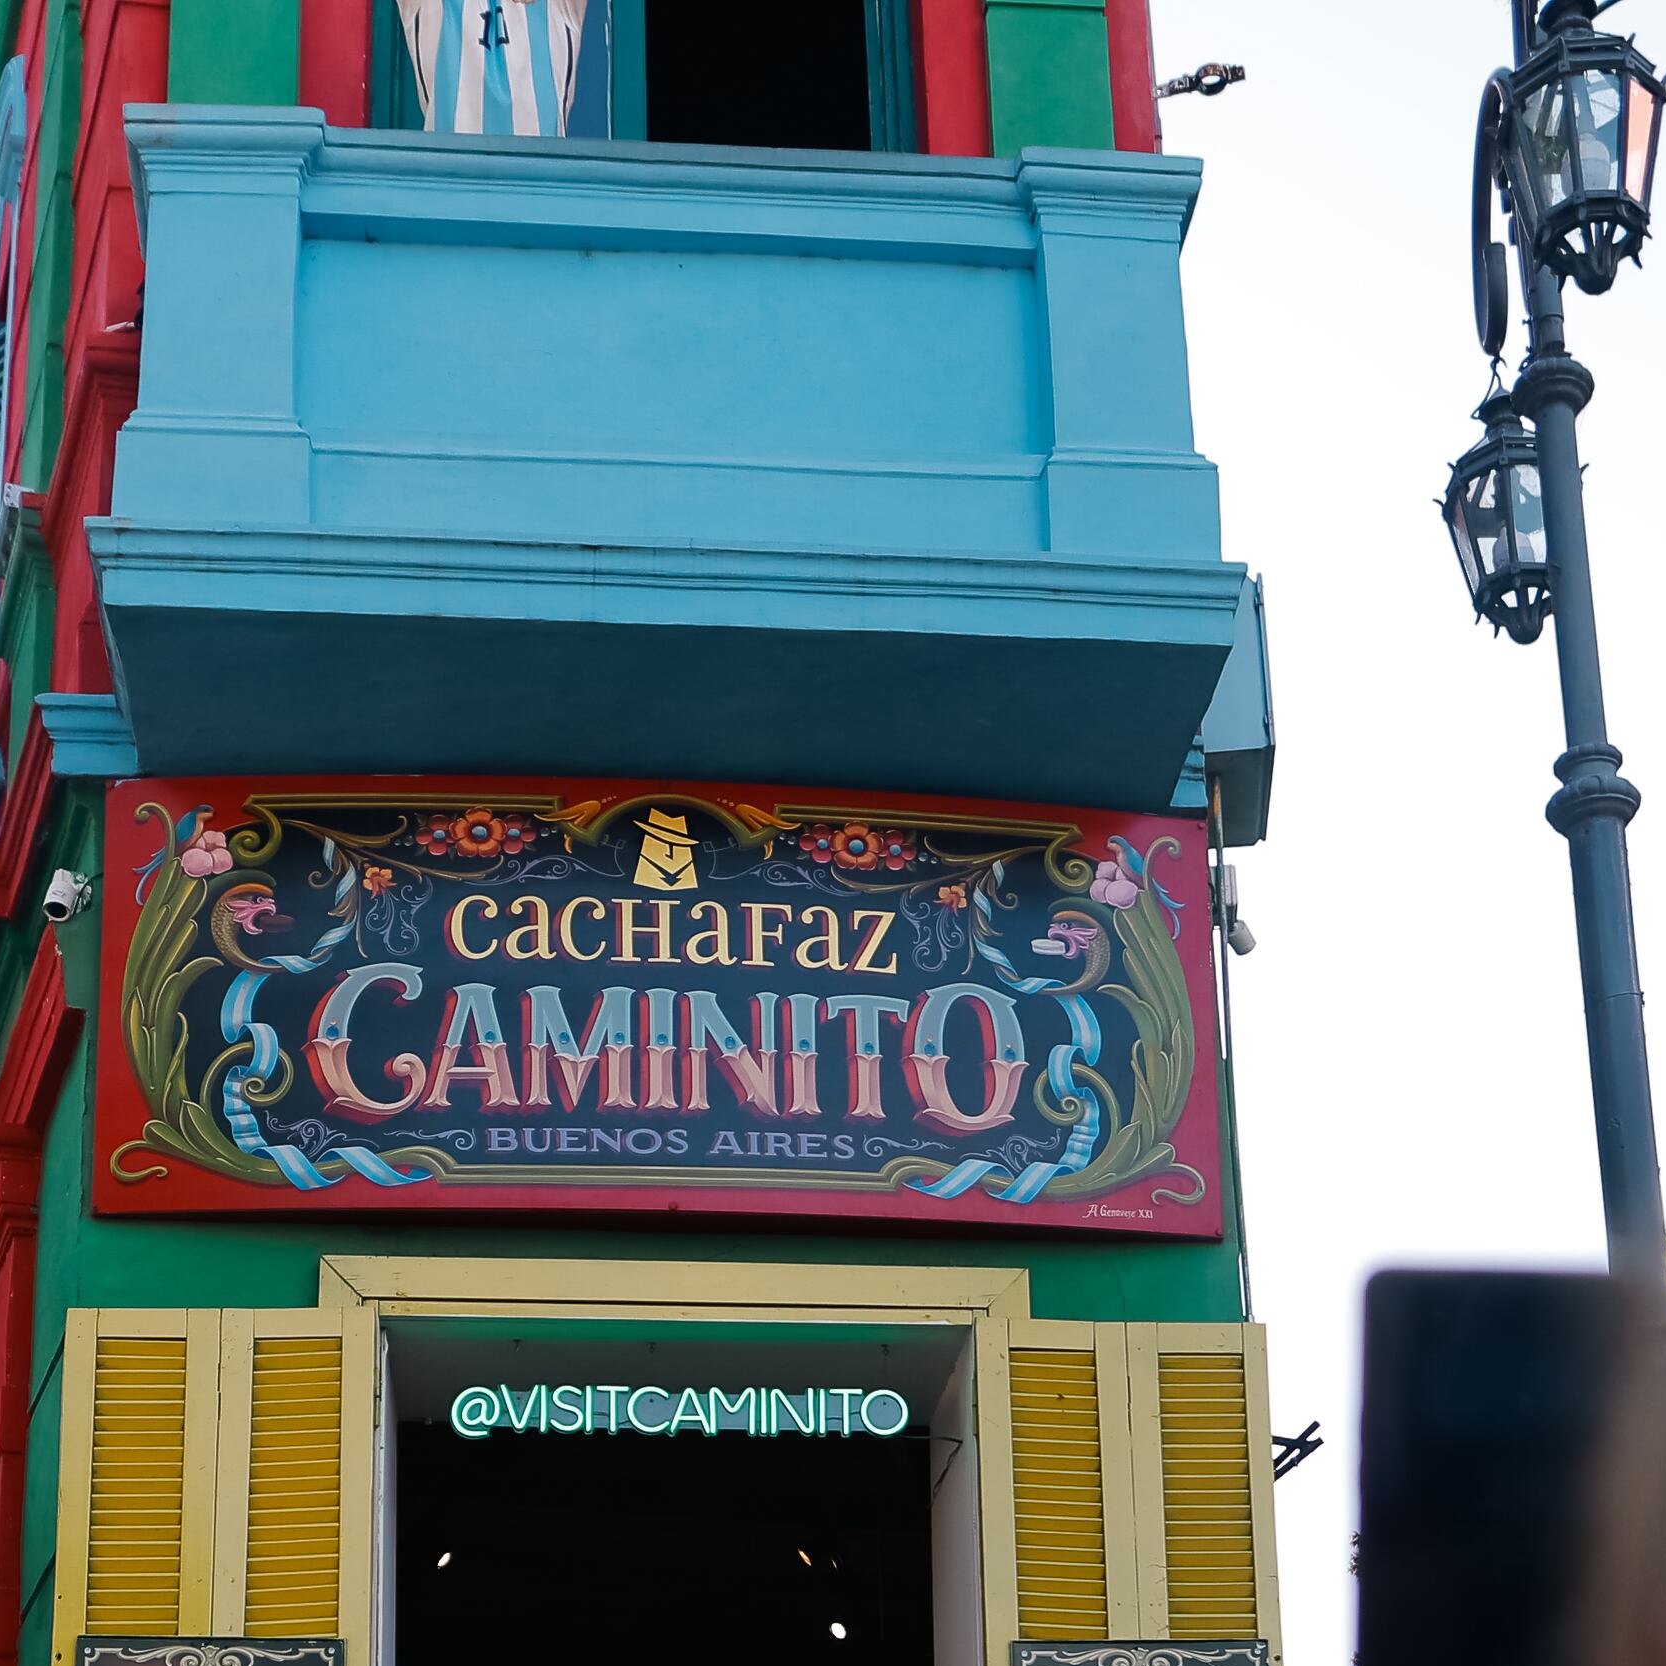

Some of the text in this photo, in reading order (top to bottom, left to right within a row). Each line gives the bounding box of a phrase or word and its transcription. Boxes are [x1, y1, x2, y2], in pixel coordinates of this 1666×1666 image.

[304, 962, 1030, 1132] CAMINITO
[486, 1127, 856, 1160] BUENOS AIRES
[450, 1383, 910, 1439] @VISITCAMINITO
